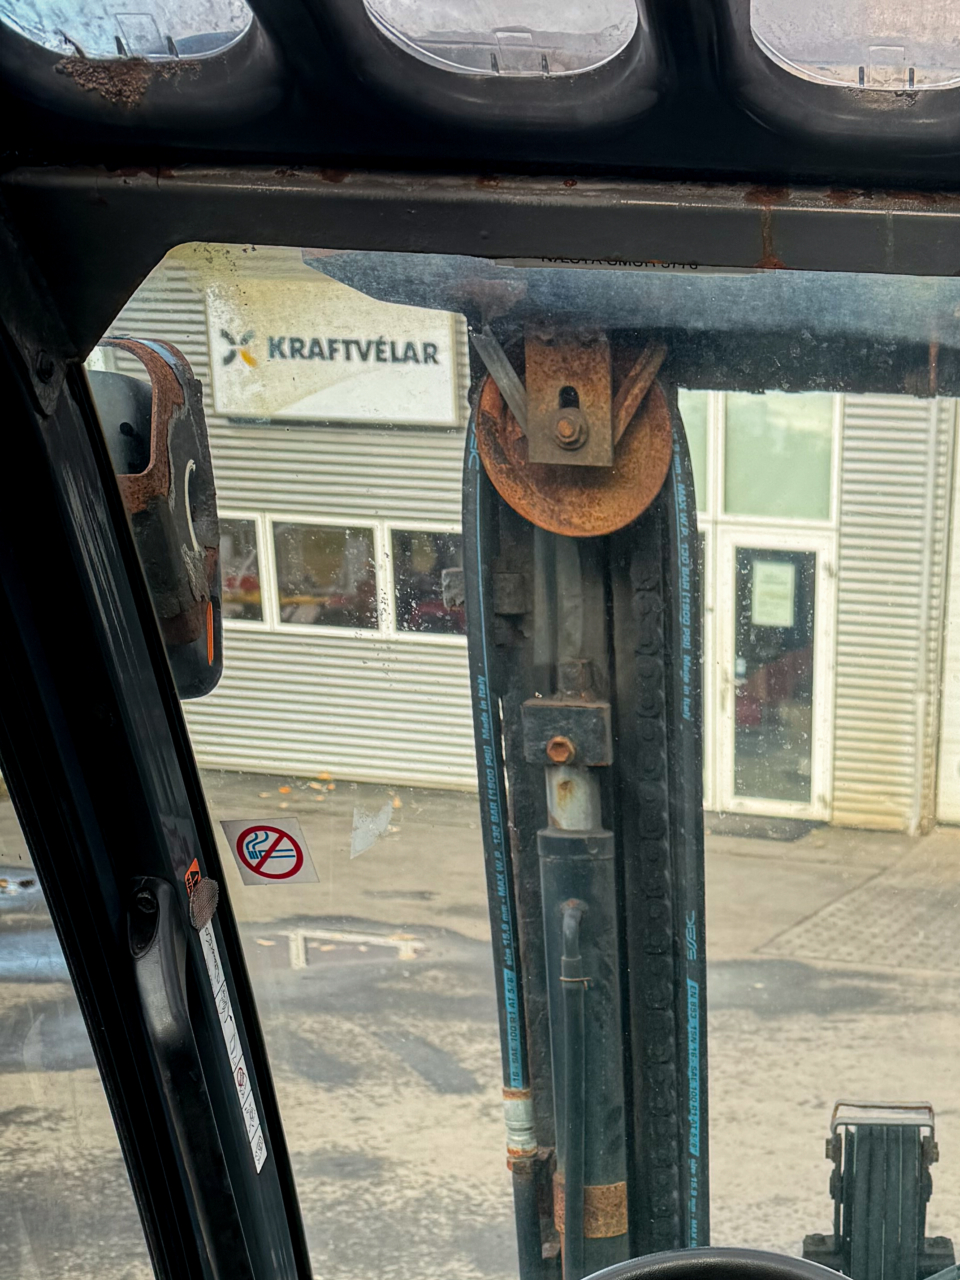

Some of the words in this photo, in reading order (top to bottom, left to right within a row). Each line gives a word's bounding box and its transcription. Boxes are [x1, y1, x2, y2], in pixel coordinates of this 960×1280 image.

[267, 334, 440, 365] KRAFTVÉLAR
[677, 483, 686, 509] MAX
[681, 542, 690, 564] 130
[681, 566, 690, 589] BAR
[681, 591, 691, 626] (1900
[682, 627, 691, 650] PSI)
[682, 655, 691, 683] Made
[477, 675, 488, 697] Italy
[683, 685, 691, 695] in
[479, 700, 489, 710] in
[682, 697, 692, 721] Italy
[482, 712, 492, 740] Made
[484, 745, 495, 767] PSI)
[487, 769, 499, 800] (1900
[490, 802, 501, 823] BAR
[492, 826, 502, 844] 130
[496, 874, 507, 897] MAX
[500, 905, 509, 922] mm
[507, 996, 516, 1008] AT
[689, 985, 697, 997] EN
[509, 1026, 518, 1042] 100
[510, 1047, 519, 1064] SAE
[690, 1066, 698, 1082] SAE
[690, 1087, 698, 1102] 100
[690, 1119, 698, 1130] AT
